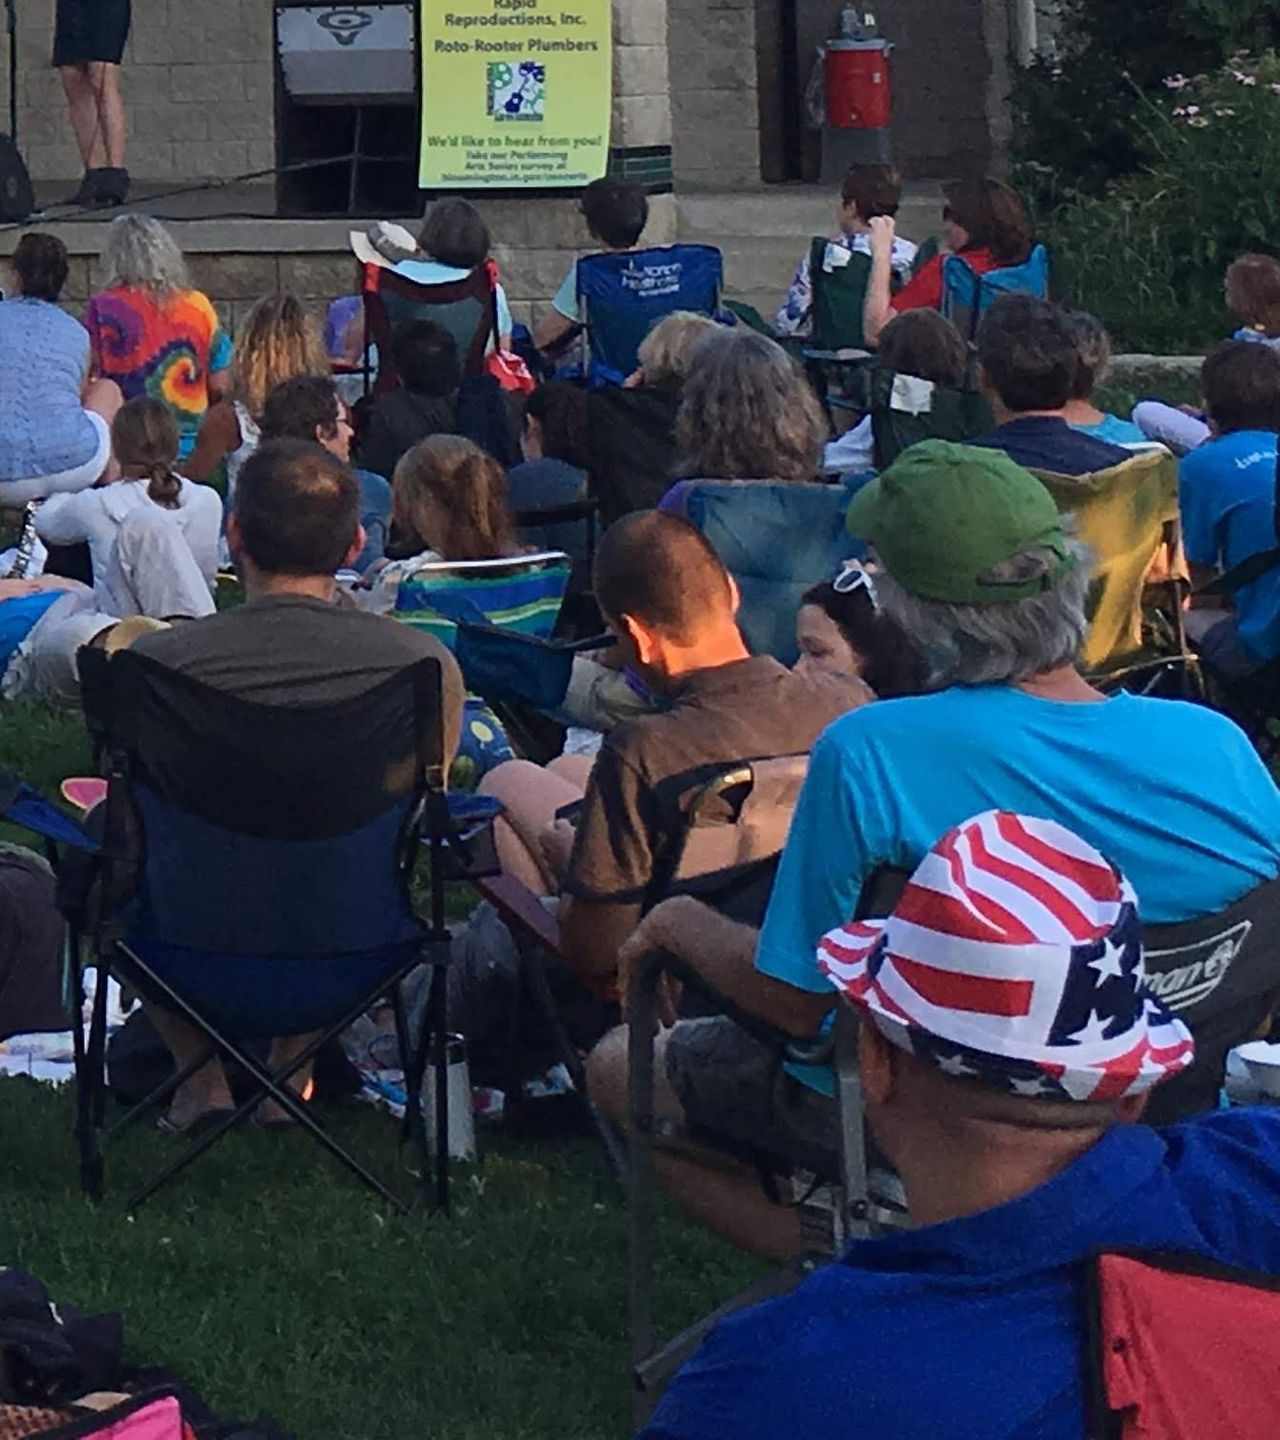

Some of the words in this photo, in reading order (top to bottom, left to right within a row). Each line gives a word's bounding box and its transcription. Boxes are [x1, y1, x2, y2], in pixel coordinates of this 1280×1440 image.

[444, 13, 557, 29] Reproductions,
[560, 13, 586, 25] Inc.
[435, 39, 523, 52] Roto-Rooter
[528, 38, 598, 51] Plumbers
[428, 135, 458, 147] We'd
[462, 135, 484, 146] like
[488, 136, 502, 146] to
[505, 136, 535, 146] hear
[538, 135, 570, 146] from
